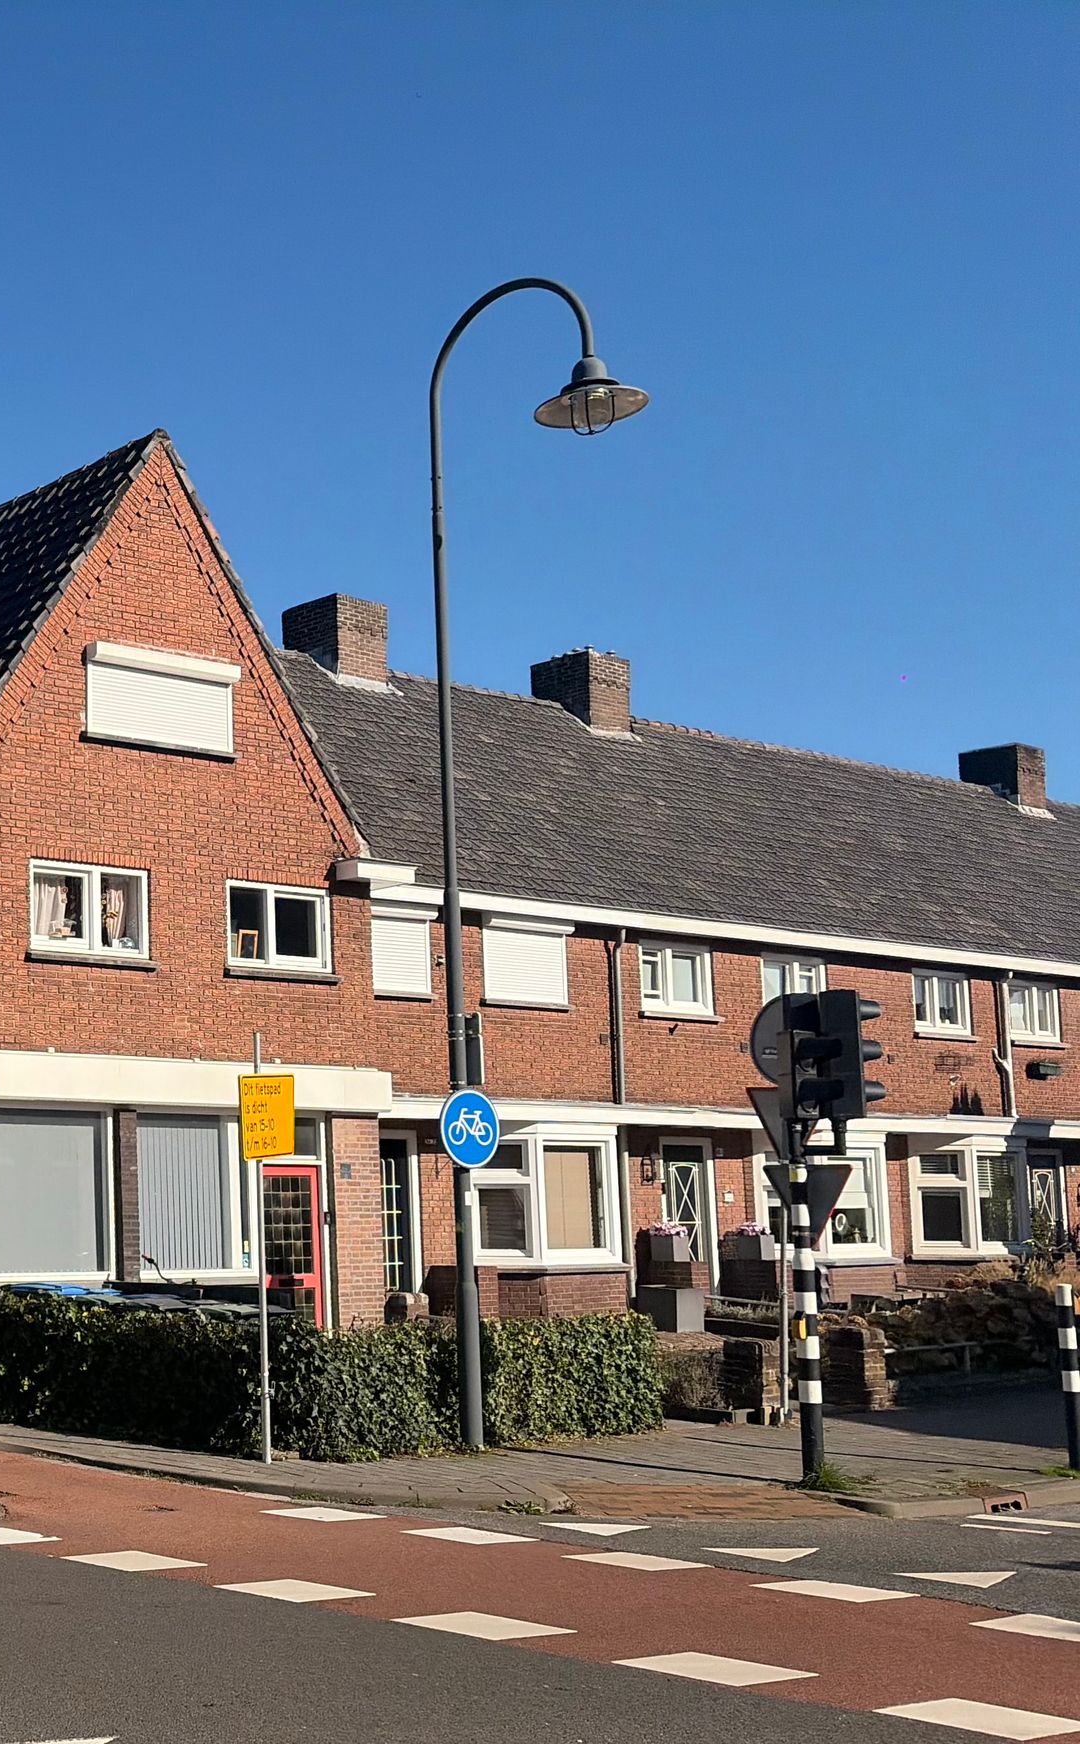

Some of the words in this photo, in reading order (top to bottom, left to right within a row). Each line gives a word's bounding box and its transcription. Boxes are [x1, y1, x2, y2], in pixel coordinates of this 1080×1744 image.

[243, 1083, 254, 1096] Dit
[255, 1082, 281, 1097] fietspad
[245, 1102, 250, 1114] is
[252, 1100, 268, 1114] dicht
[245, 1121, 258, 1133] van
[259, 1118, 275, 1131] 15-10
[246, 1136, 260, 1152] t/m
[261, 1136, 277, 1150] 16-10
